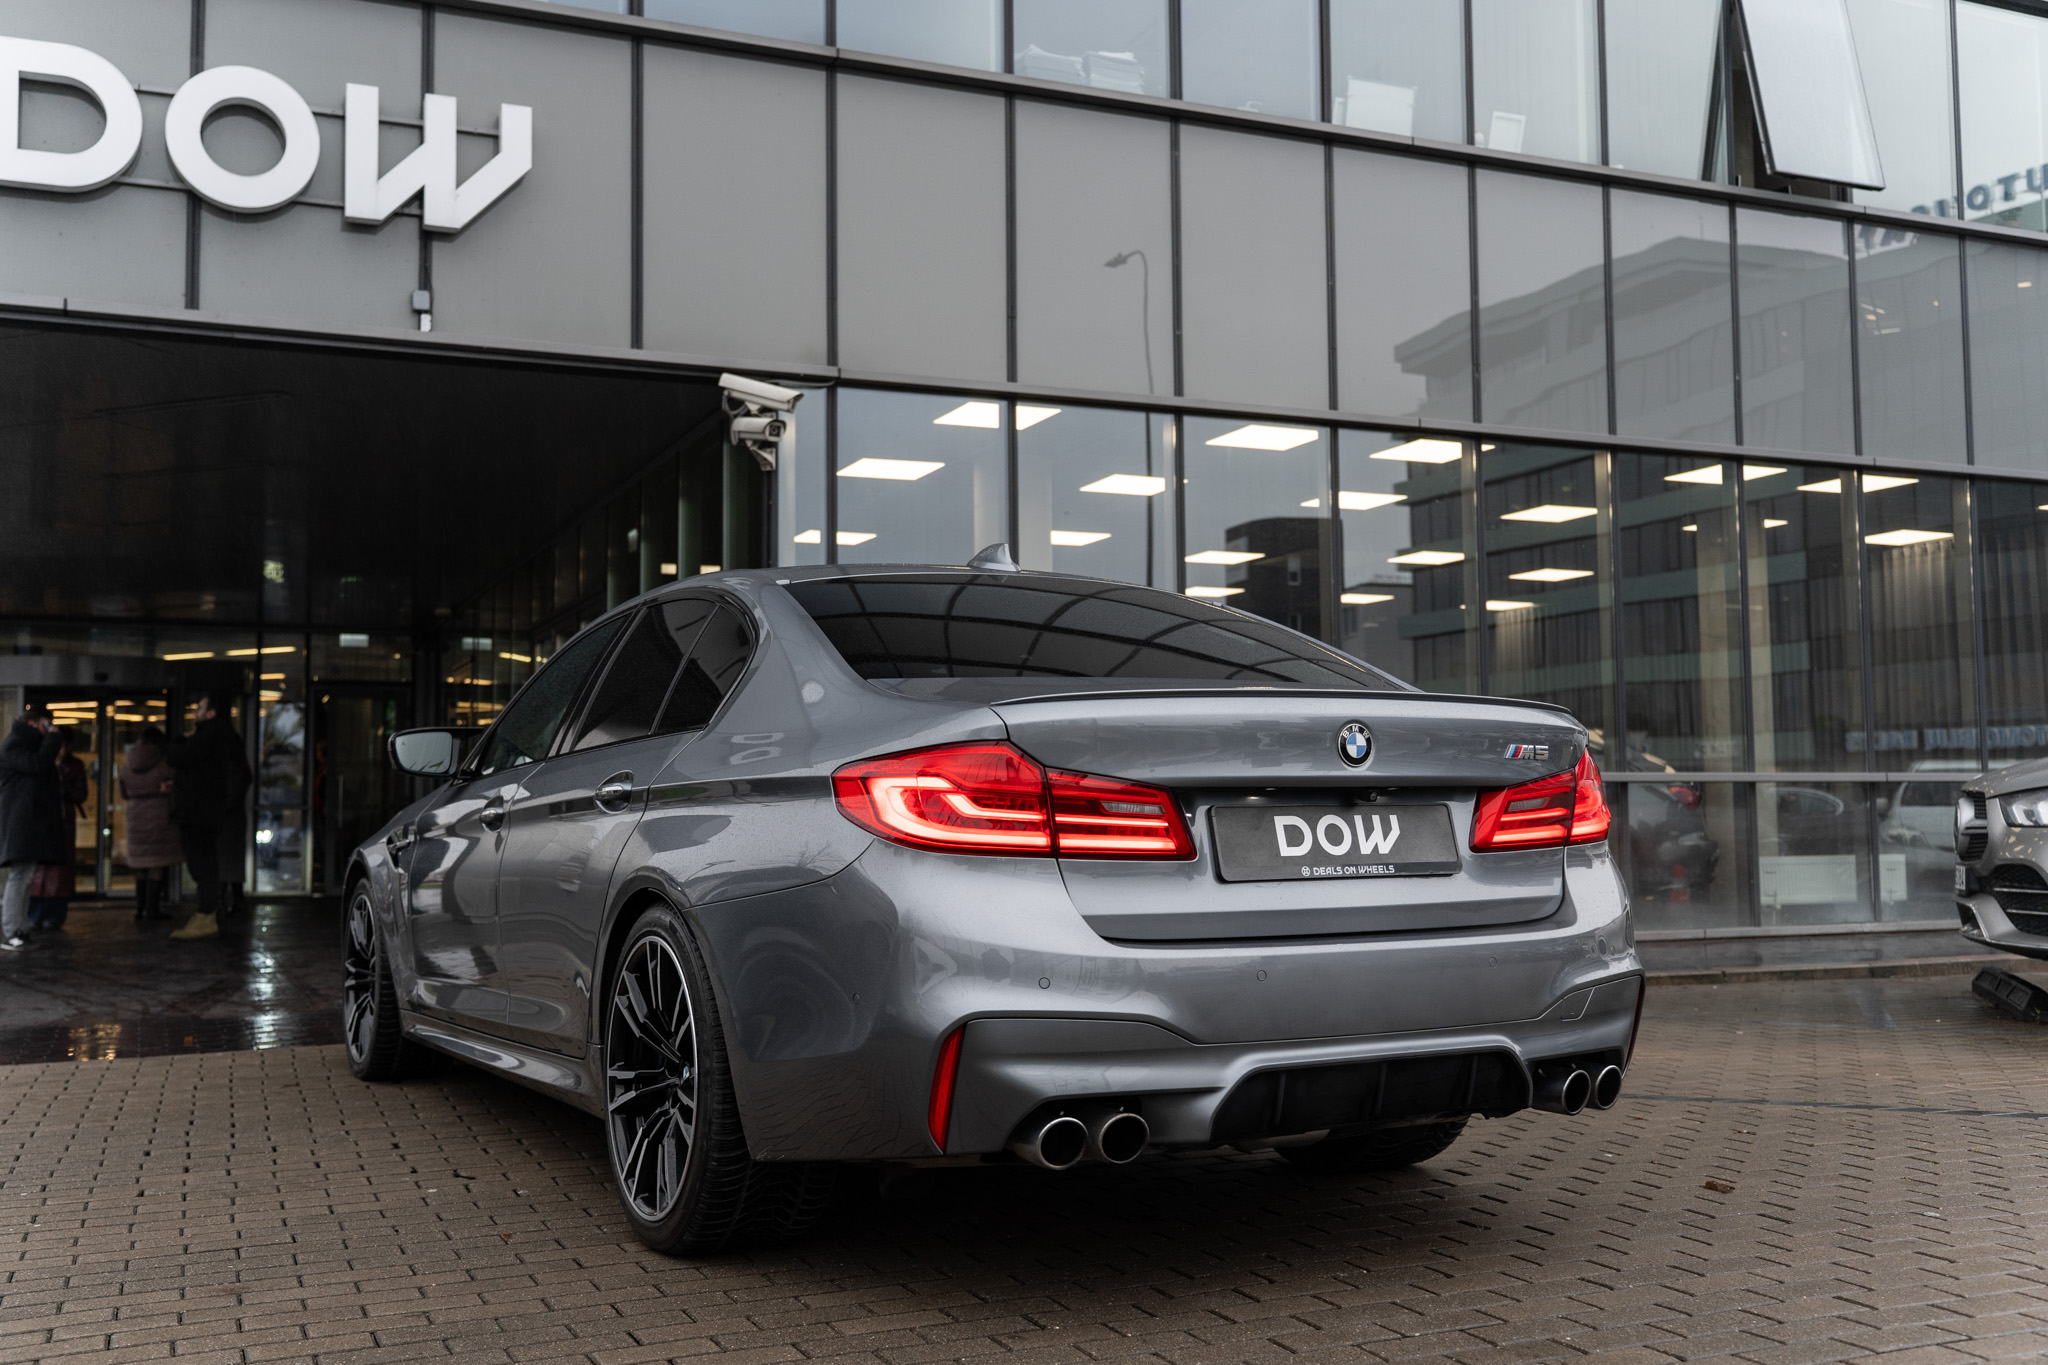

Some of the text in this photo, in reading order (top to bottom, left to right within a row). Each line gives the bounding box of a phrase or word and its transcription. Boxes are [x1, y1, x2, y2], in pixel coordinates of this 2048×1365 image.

[0, 36, 533, 233] DOW
[1342, 725, 1371, 739] BMW
[1273, 814, 1401, 857] DOW
[1313, 865, 1395, 876] DEALS ON WHEELS
